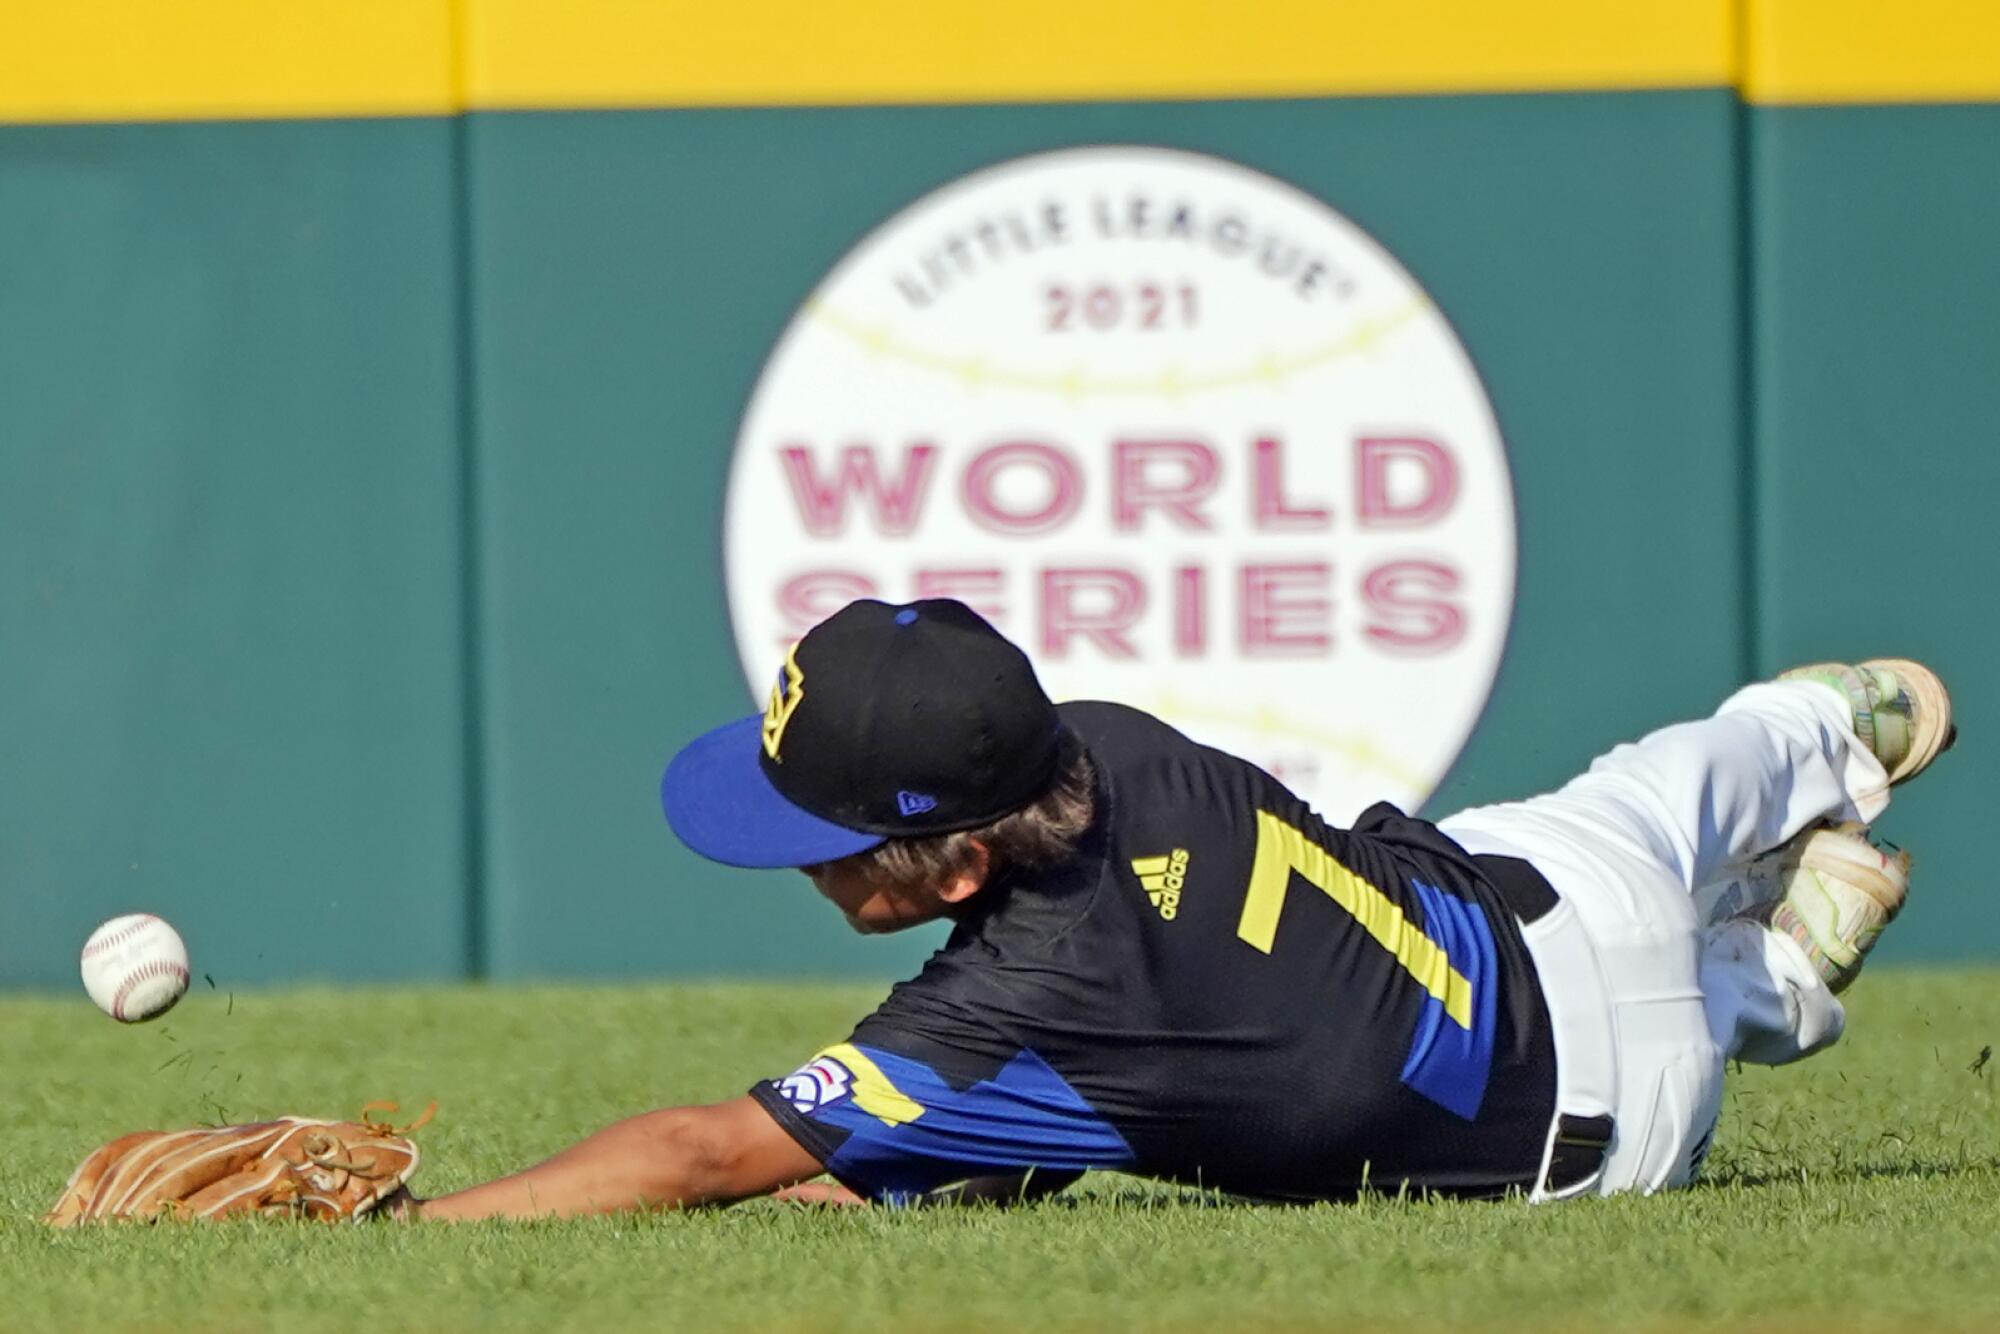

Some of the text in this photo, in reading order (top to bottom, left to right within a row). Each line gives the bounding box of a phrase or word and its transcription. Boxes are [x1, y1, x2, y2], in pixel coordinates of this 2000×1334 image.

[894, 198, 1067, 308] LITTLE
[1046, 283, 1200, 332] 2021
[778, 436, 1463, 537] WORLD
[1160, 848, 1190, 920] adidas
[1237, 809, 1472, 1031] 7
